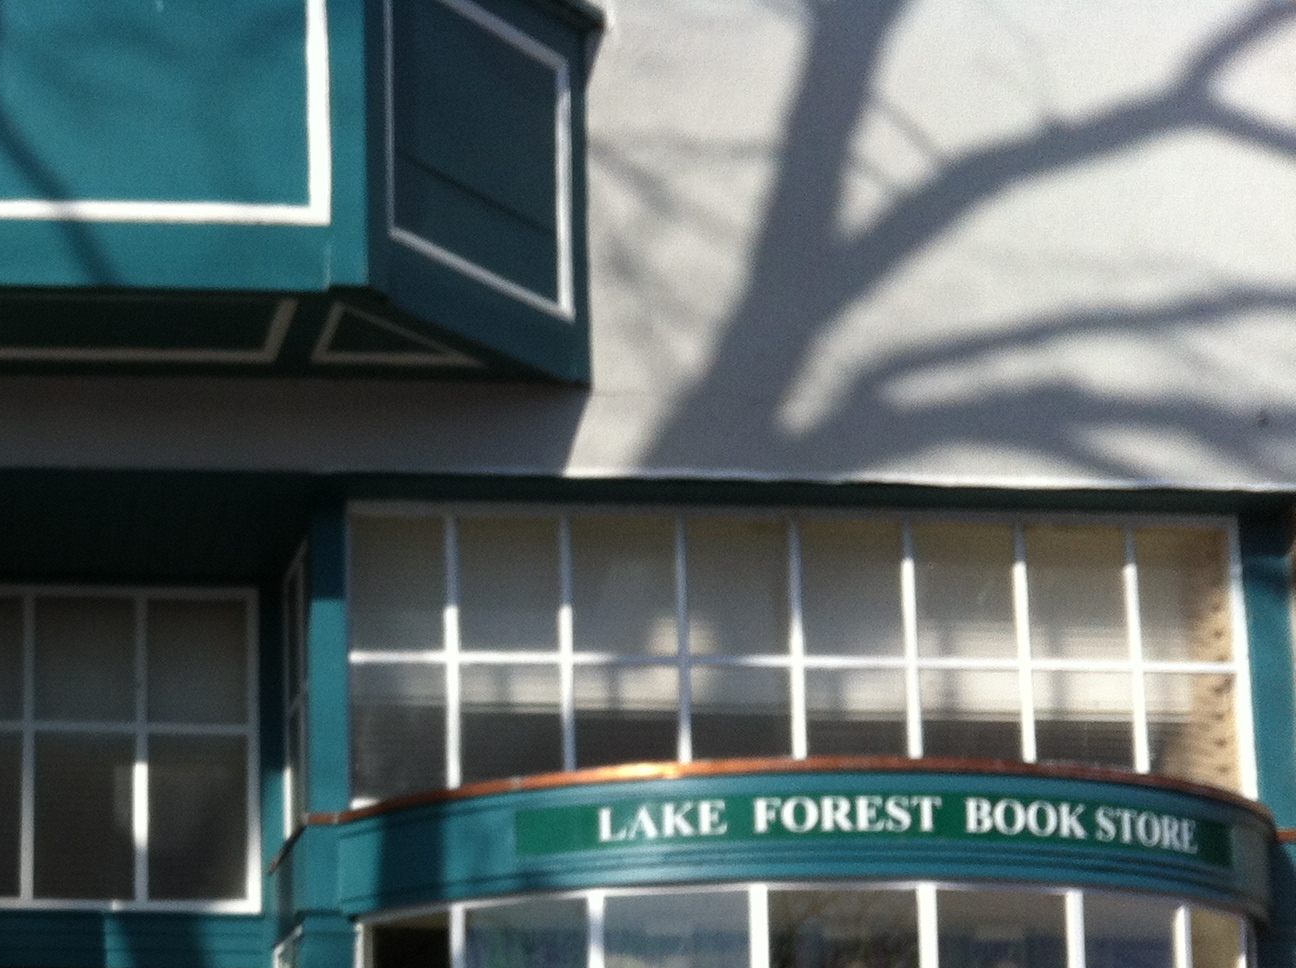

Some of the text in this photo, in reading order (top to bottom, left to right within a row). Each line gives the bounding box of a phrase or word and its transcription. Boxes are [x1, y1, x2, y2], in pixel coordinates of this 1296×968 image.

[597, 795, 1198, 855] LAKE FOREST BOOK STORE
